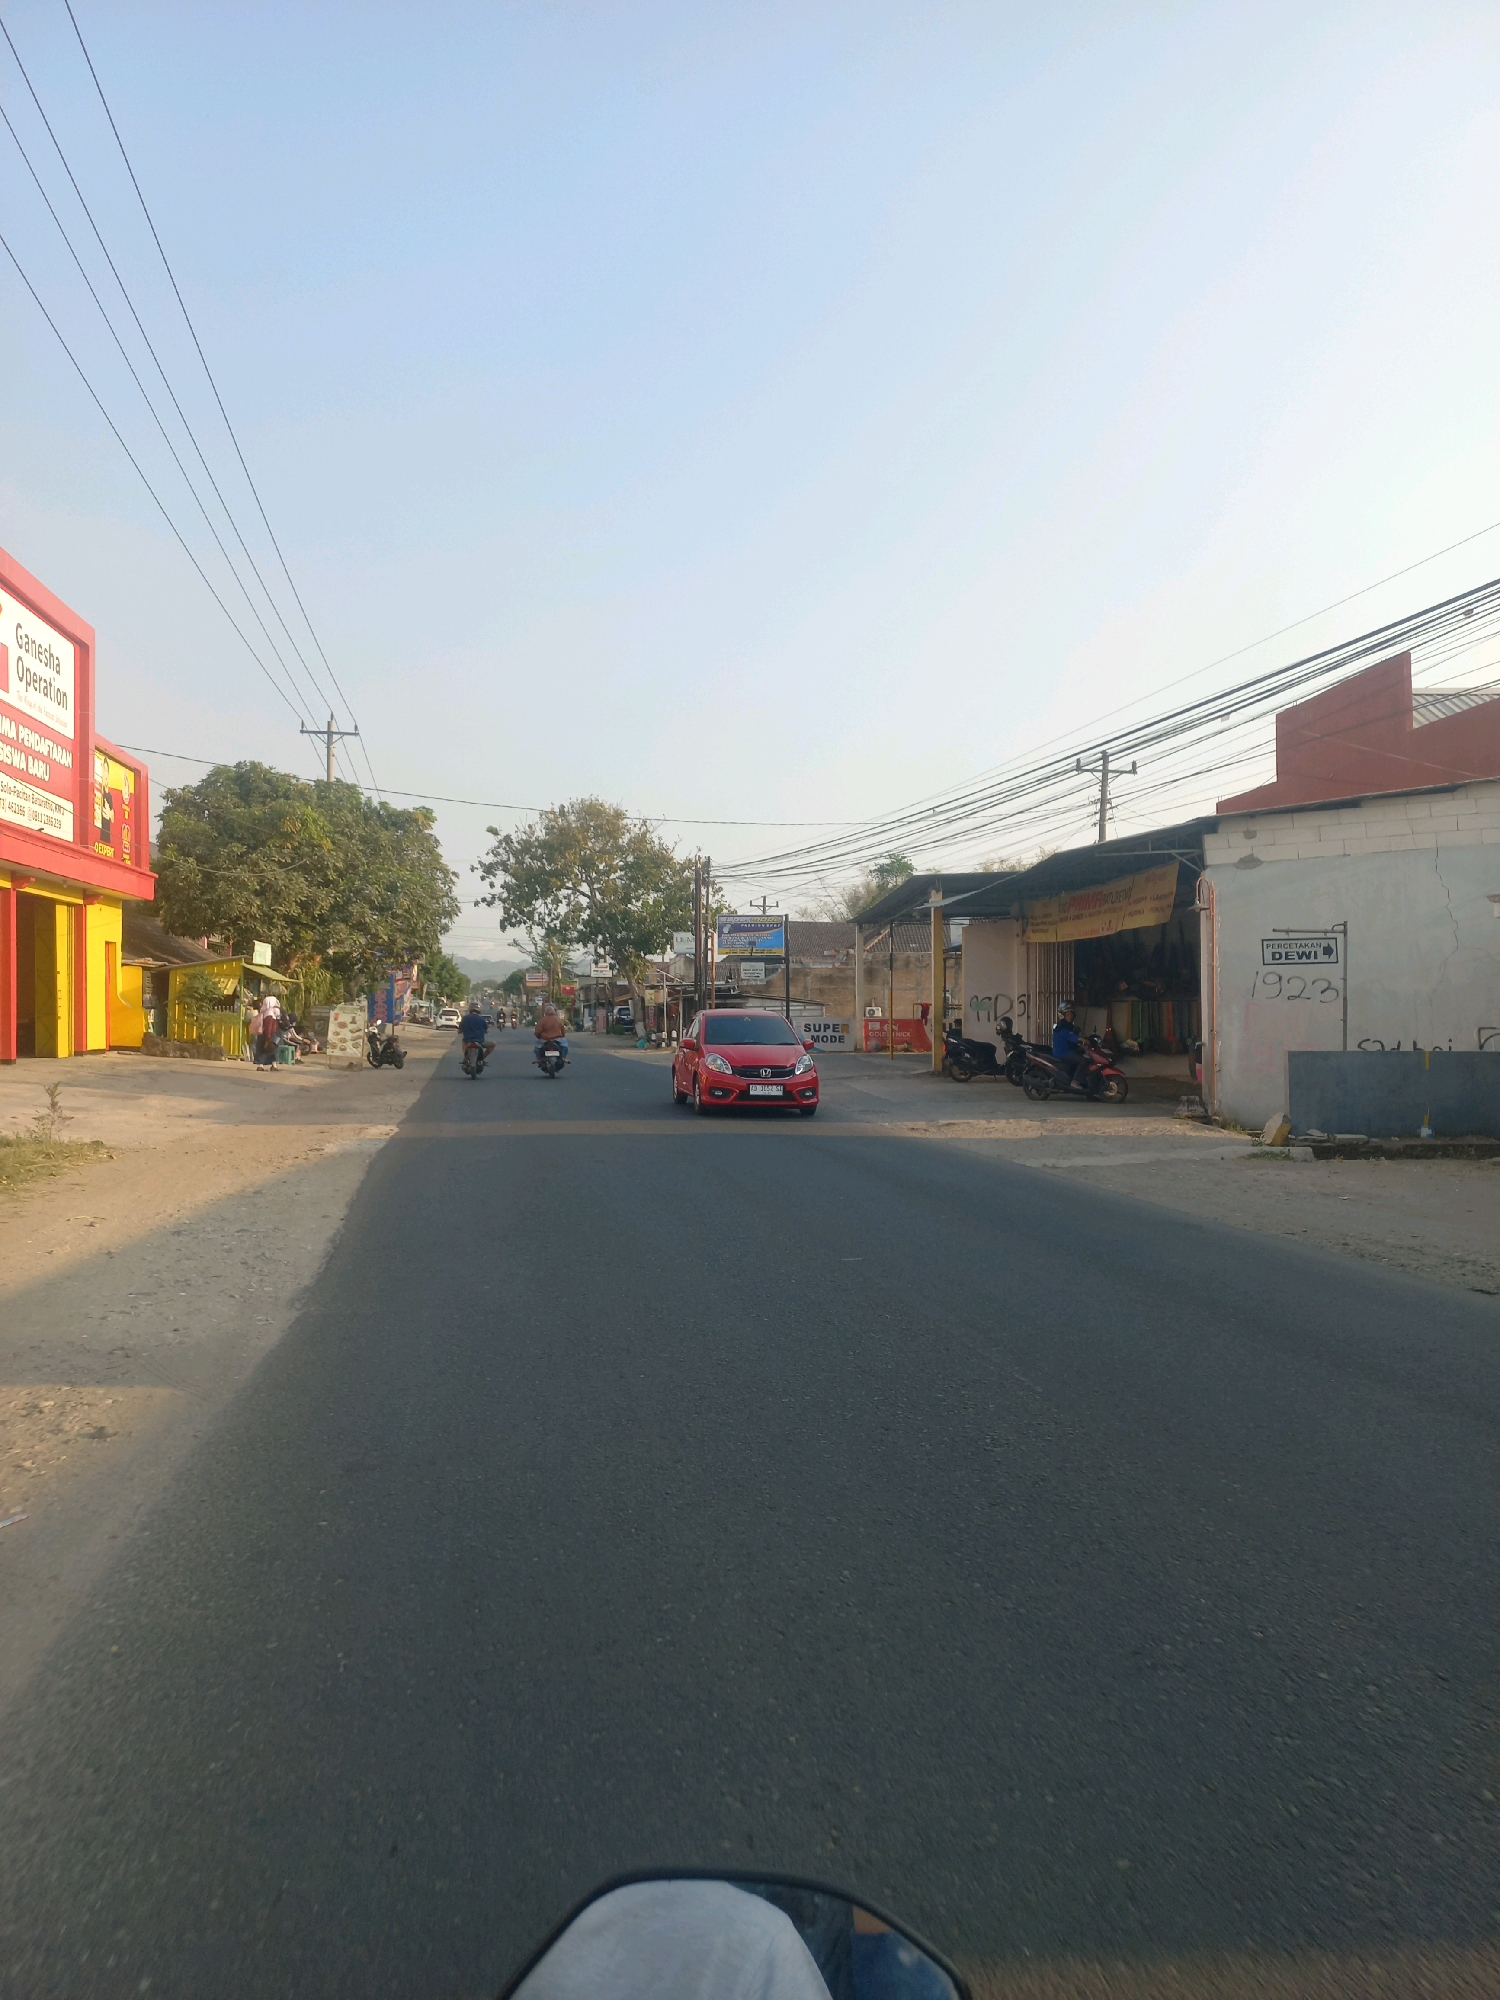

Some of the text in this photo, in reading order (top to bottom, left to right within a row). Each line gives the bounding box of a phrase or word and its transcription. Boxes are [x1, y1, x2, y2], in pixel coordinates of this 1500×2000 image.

[15, 622, 61, 676] Ganesha
[16, 655, 68, 710] Operation
[18, 723, 72, 769] PENDAFTARAN
[27, 754, 50, 782] BARU
[1266, 942, 1322, 950] PERCETAKAN
[1271, 950, 1319, 961] DEWI
[1251, 970, 1340, 1004] 1923
[803, 1022, 850, 1034] SUPER
[810, 1034, 846, 1044] MODE
